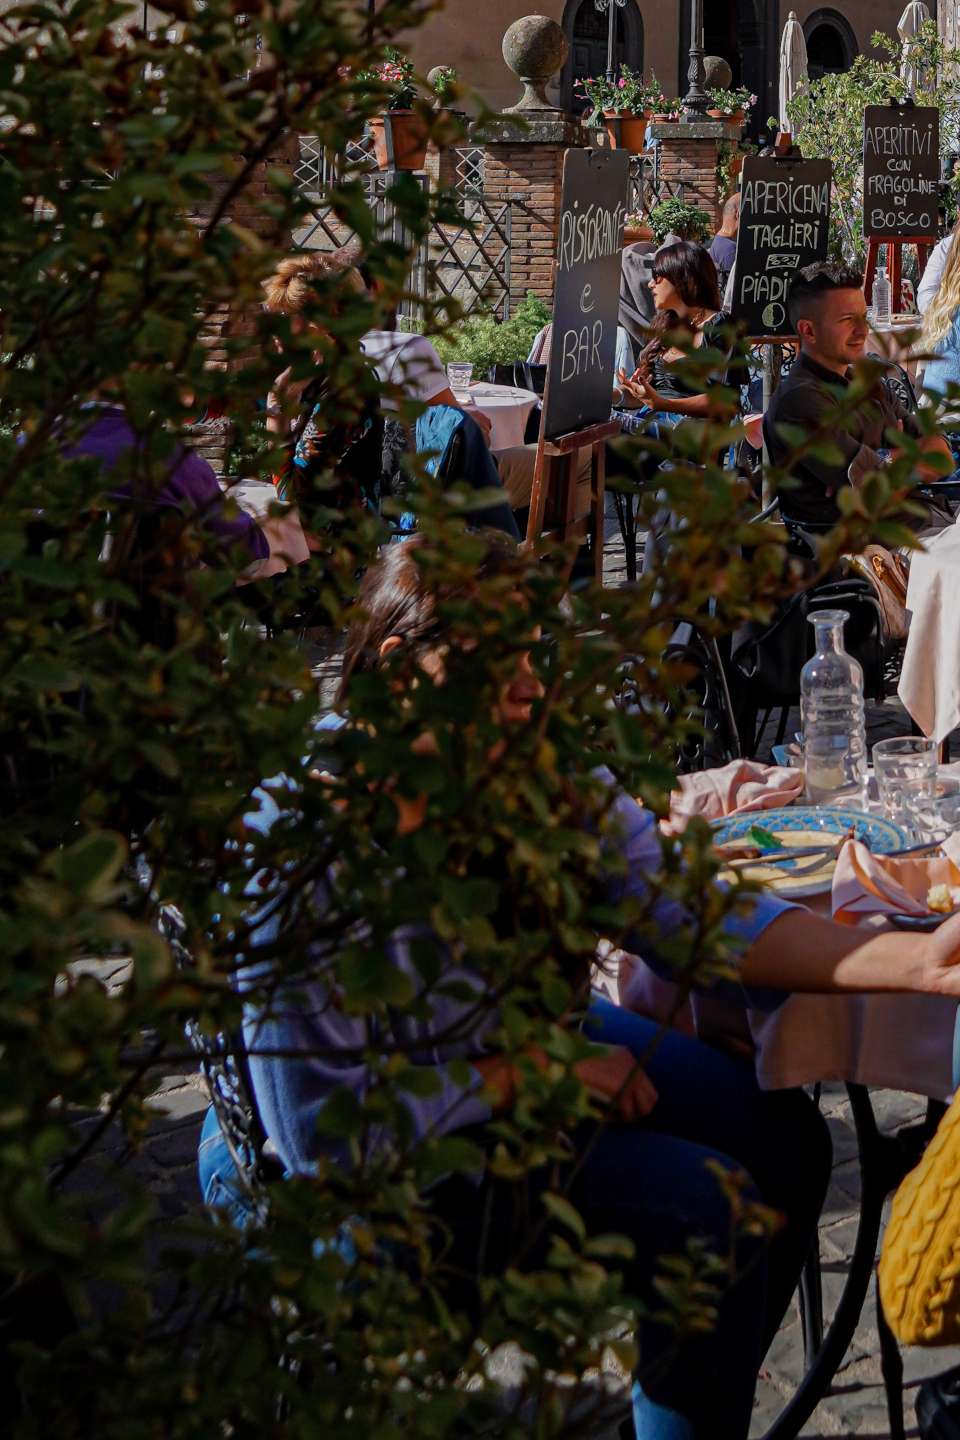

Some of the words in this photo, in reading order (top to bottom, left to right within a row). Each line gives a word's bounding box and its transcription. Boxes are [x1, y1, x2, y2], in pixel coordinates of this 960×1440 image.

[864, 123, 932, 155] APERITIVI
[887, 159, 911, 172] CON
[741, 176, 829, 216] APERICENA
[868, 173, 937, 196] FRAGOLINE
[747, 218, 820, 250] TAGLIERI
[871, 208, 931, 229] BOSCO
[560, 200, 626, 272] RISTORANTE
[561, 320, 604, 383] BAR
